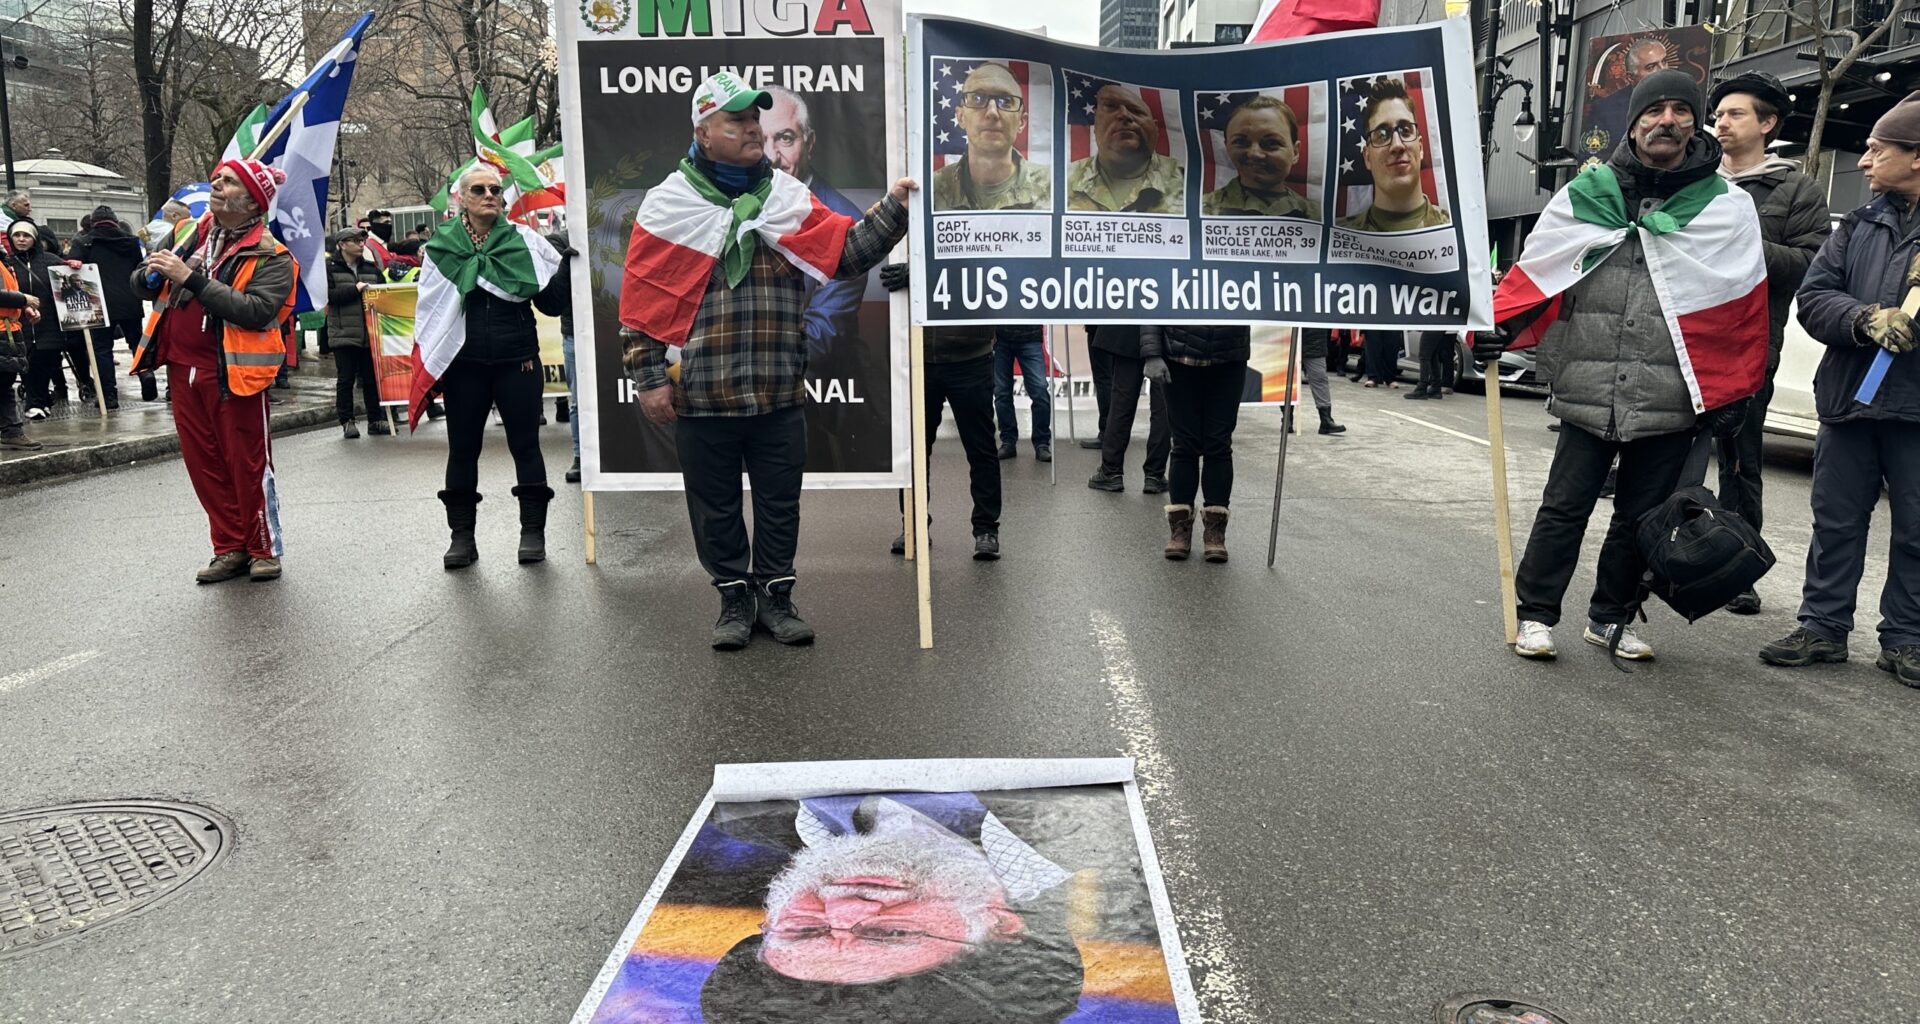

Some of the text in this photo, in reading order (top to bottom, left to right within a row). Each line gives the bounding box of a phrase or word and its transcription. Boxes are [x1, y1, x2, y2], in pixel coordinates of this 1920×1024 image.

[600, 66, 693, 93] LONG
[782, 65, 864, 93] IRAN
[937, 221, 971, 232] CAPT.
[1065, 220, 1162, 233] SGT. 1ST CLASS
[1205, 225, 1304, 237] SGT. 1ST CLASS
[937, 231, 1042, 244] CODY KHORK, 35
[1065, 232, 1184, 245] NOAH TIETJENS, 42
[1205, 236, 1316, 249] NICOLE AMOR, 39
[1333, 231, 1360, 243] SGT.
[937, 244, 1003, 253] WINTER HAVEN, FL
[1065, 244, 1104, 253] BELLEVUE,
[1252, 250, 1273, 258] LAKE,
[1332, 239, 1454, 260] DECLAN COADY, 20
[1331, 250, 1352, 258] WEST
[1355, 252, 1370, 260] DES
[932, 266, 1460, 316] 4 US soldiers killed in Iran war.
